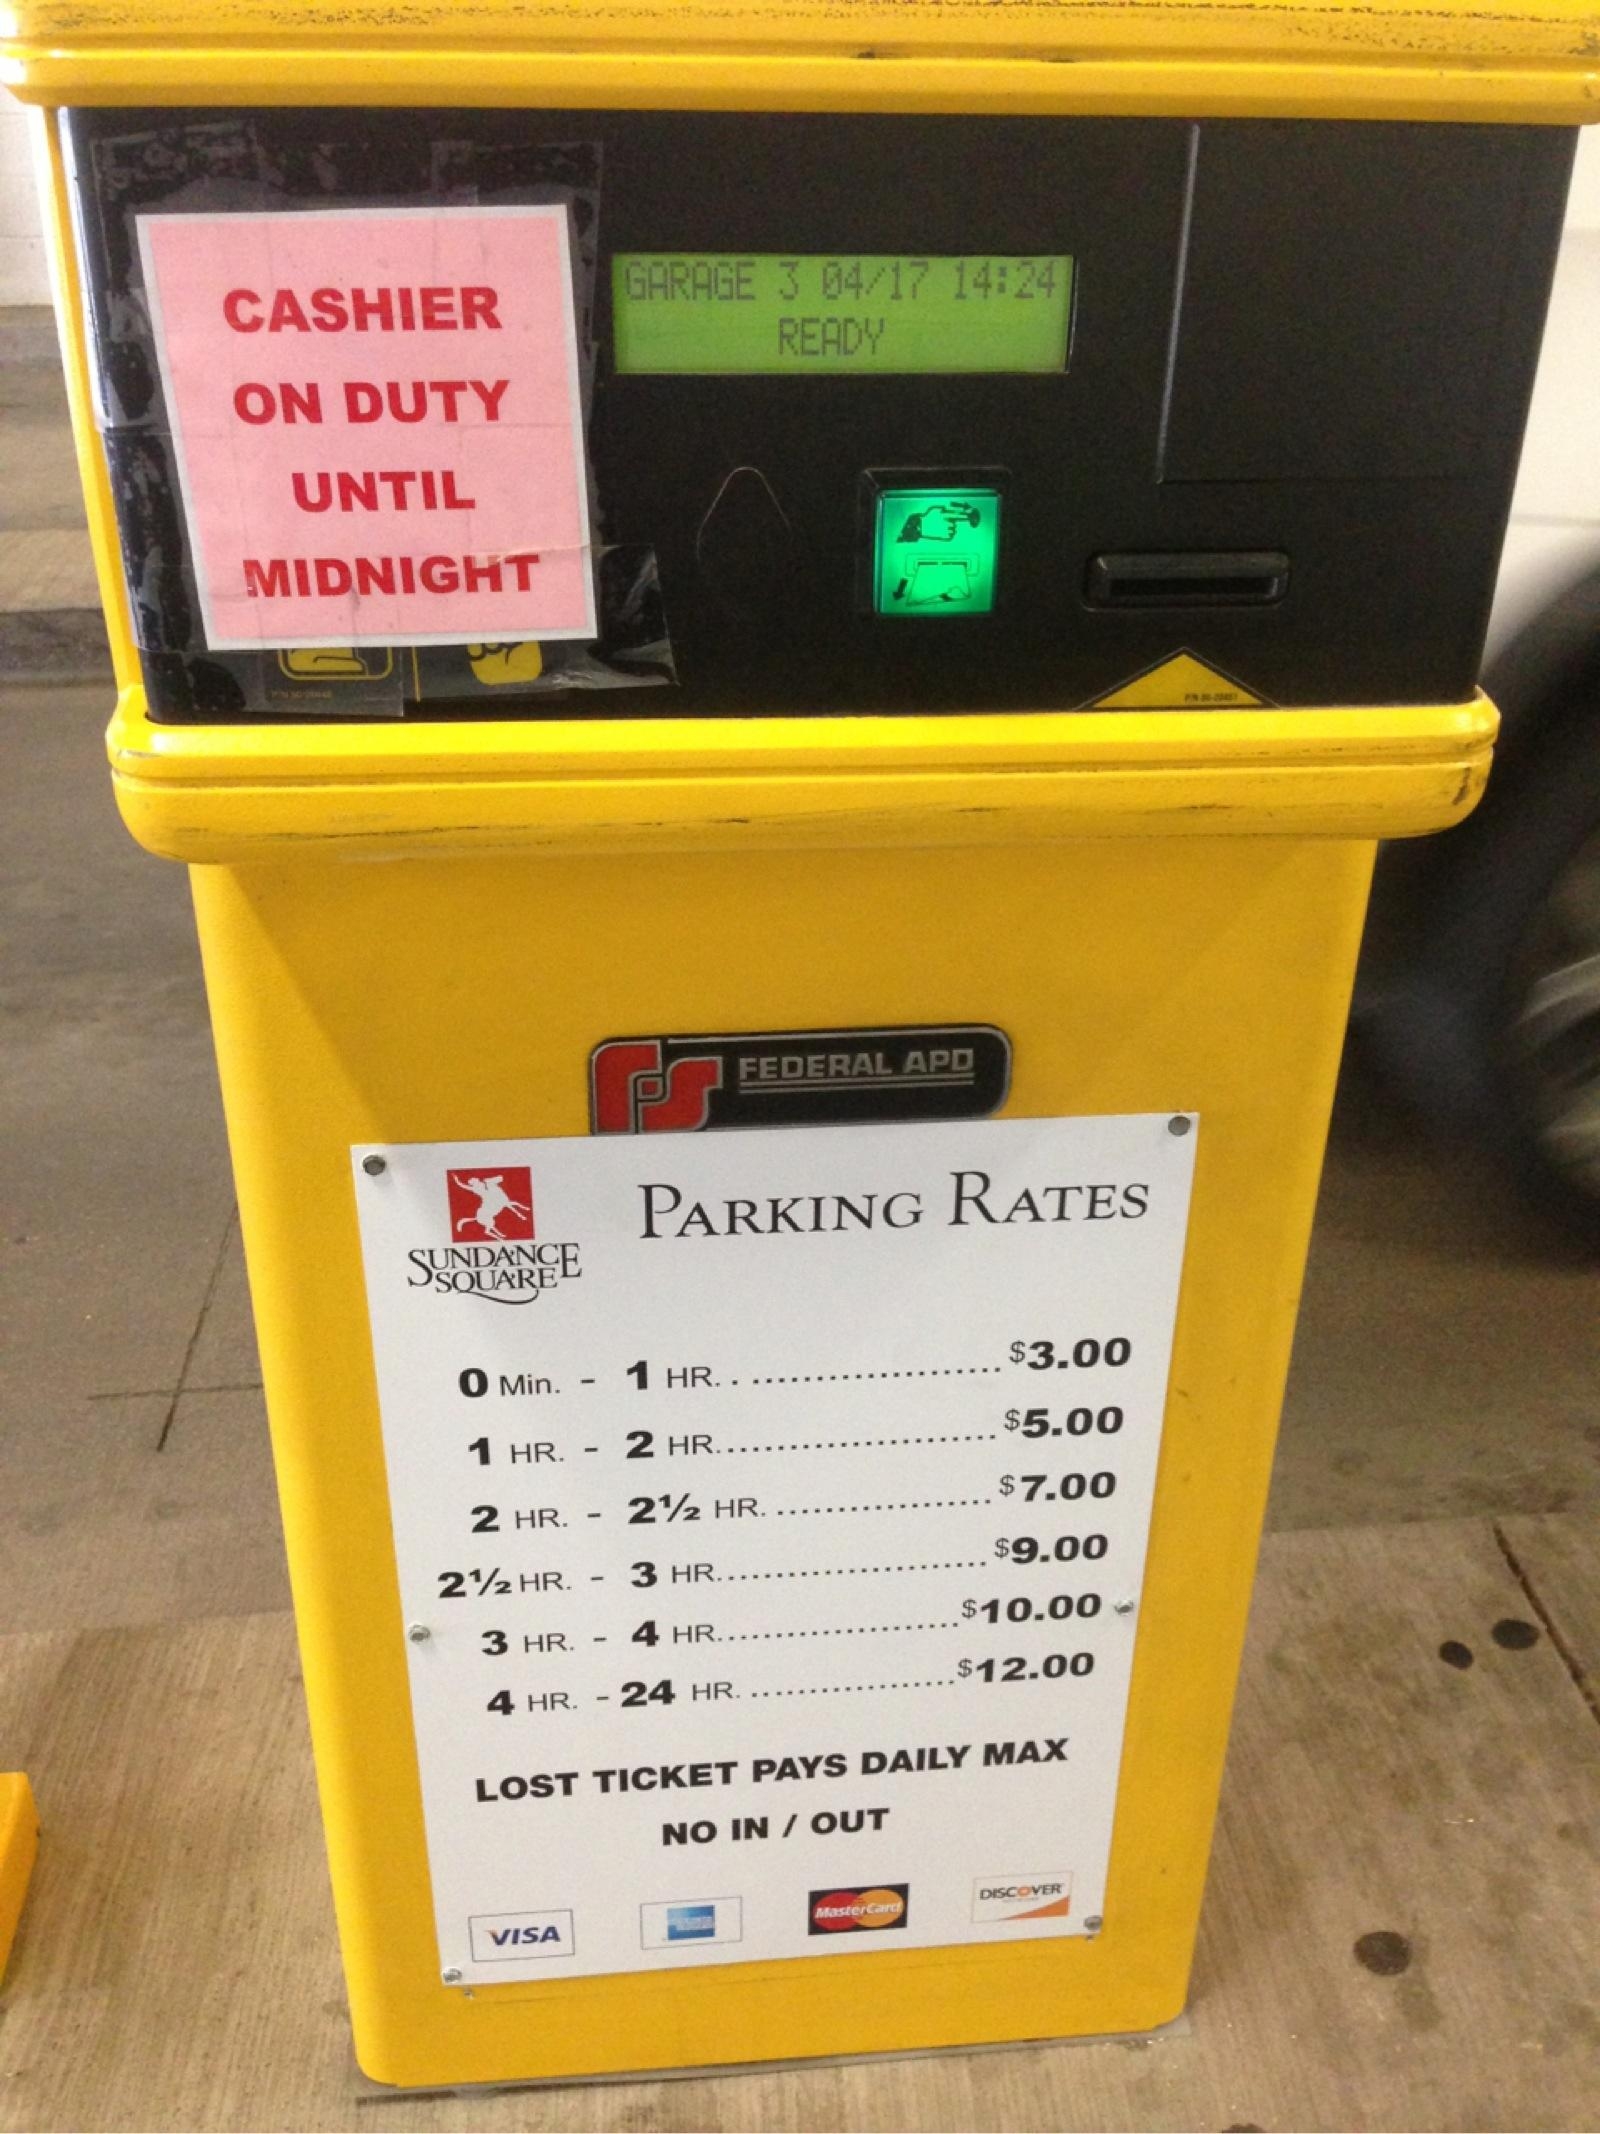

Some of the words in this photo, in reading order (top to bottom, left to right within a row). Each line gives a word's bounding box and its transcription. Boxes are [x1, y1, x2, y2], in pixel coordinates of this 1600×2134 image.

[624, 260, 757, 301] GARAGE
[778, 260, 801, 301] 3
[821, 260, 930, 300] 04/17
[953, 260, 1057, 300] 14:24
[223, 286, 503, 333] CASHIER
[777, 317, 886, 357] READY
[233, 382, 323, 425] ON
[344, 380, 510, 423] DUTY
[292, 470, 476, 513] UNTIL
[243, 554, 539, 598] MIDNIGHT
[738, 1052, 893, 1082] FEDERAL
[902, 1047, 975, 1074] APD
[637, 1183, 924, 1239] PARKING
[947, 1170, 1149, 1226] RATES
[406, 1242, 584, 1288] SUNDANCE
[434, 1267, 560, 1306] SQUARE
[457, 1367, 489, 1399] 0
[499, 1373, 561, 1397] Min.
[626, 1359, 649, 1391] 1
[1008, 1336, 1132, 1371] $3.00
[467, 1436, 491, 1466] 1
[509, 1441, 565, 1465] HR.
[625, 1429, 655, 1460] 2
[1003, 1405, 1124, 1439] $5.00
[470, 1504, 501, 1534] 2
[514, 1507, 568, 1530] HR.
[998, 1471, 1118, 1503] $7.00
[519, 1571, 573, 1593] HR.
[630, 1561, 658, 1589] 3
[994, 1532, 1109, 1566] $9.00
[481, 1629, 509, 1657] 3
[523, 1632, 574, 1654] HR.
[631, 1619, 661, 1648] 4
[961, 1592, 1103, 1625] $10.00
[486, 1689, 516, 1717] 4
[527, 1692, 578, 1713] HR.
[620, 1678, 677, 1709] 24
[957, 1651, 1096, 1684] $12.00
[475, 1771, 580, 1803] LOST
[591, 1760, 739, 1794] TICKET
[752, 1752, 848, 1784] PAYS
[860, 1744, 973, 1776] DAILY
[982, 1737, 1069, 1768] MAX
[661, 1819, 718, 1847] NO
[731, 1815, 769, 1842] IN
[809, 1807, 891, 1836] OUT
[815, 1900, 904, 1919] MasterCard
[979, 1883, 1062, 1900] DISCOVER
[487, 1926, 561, 1946] VISA
